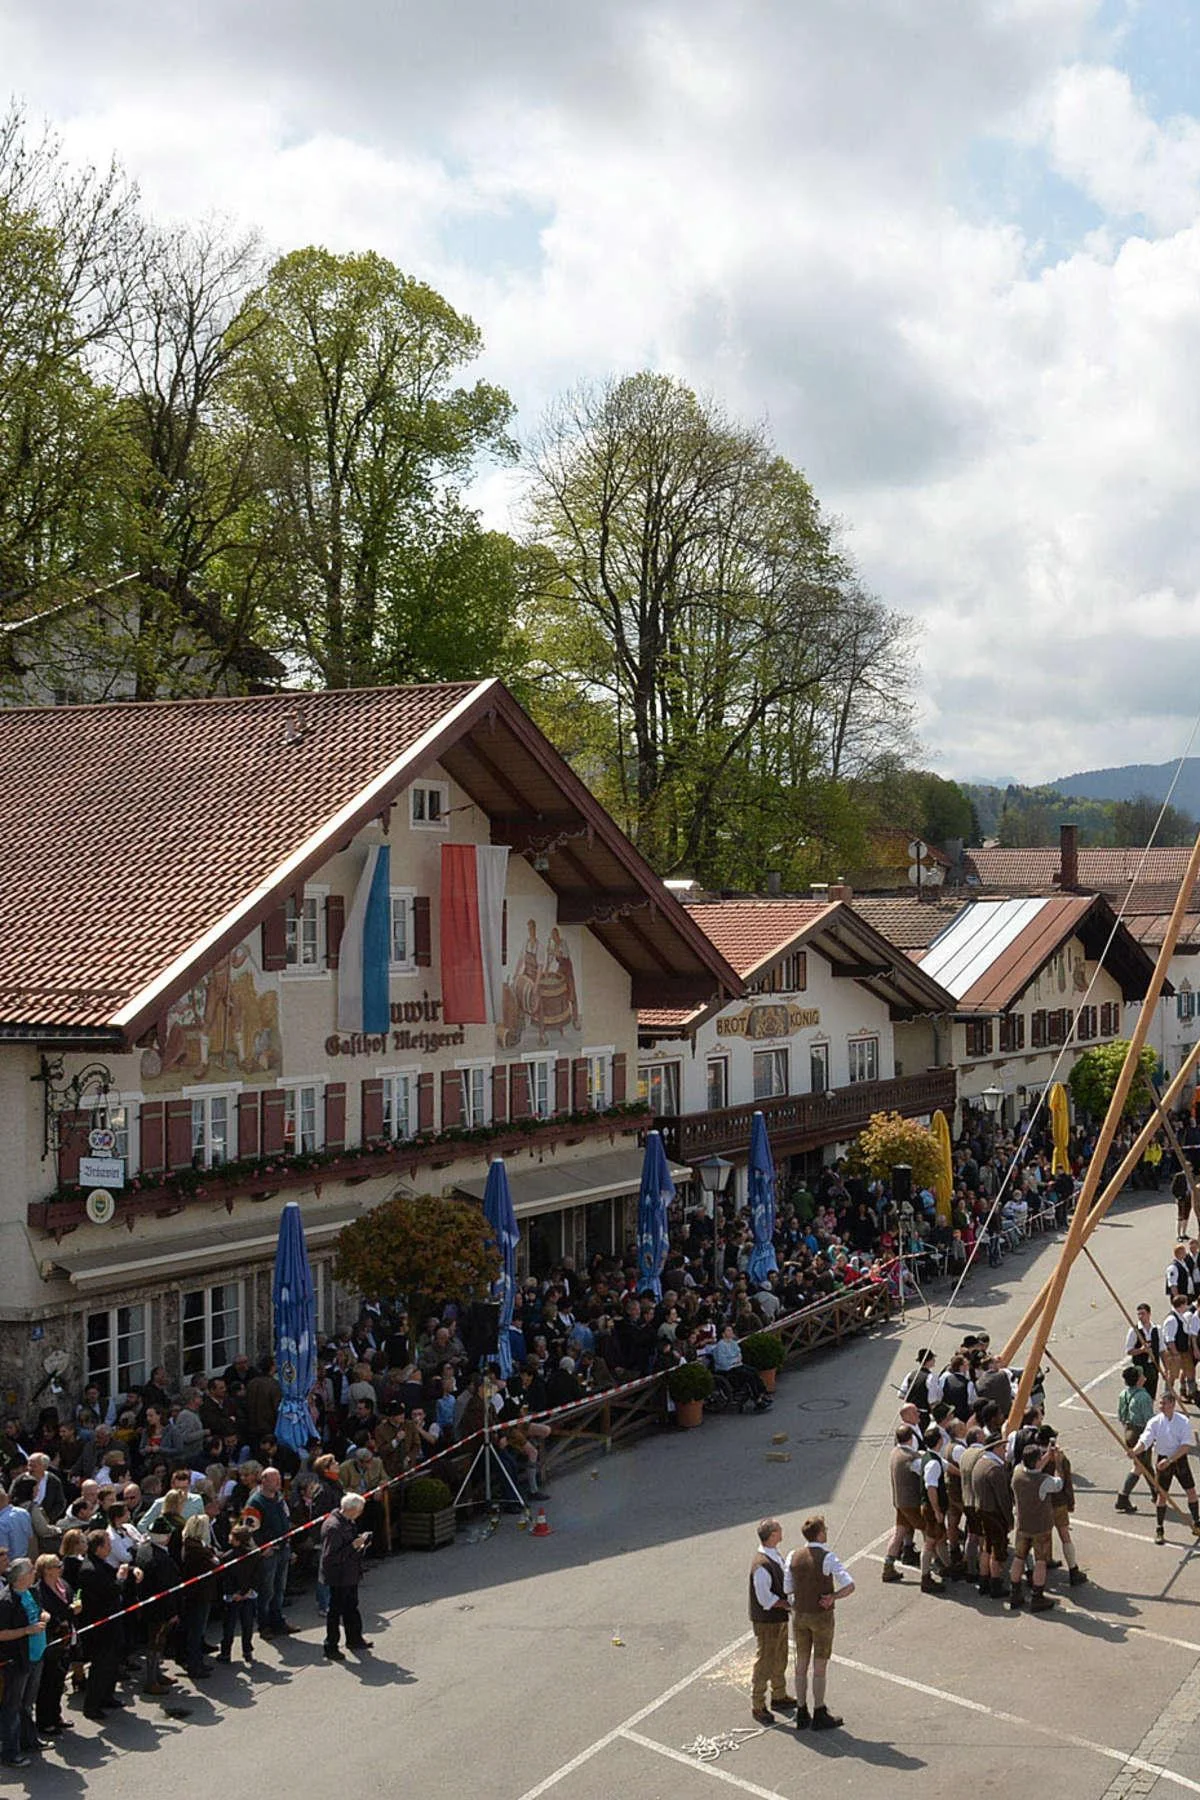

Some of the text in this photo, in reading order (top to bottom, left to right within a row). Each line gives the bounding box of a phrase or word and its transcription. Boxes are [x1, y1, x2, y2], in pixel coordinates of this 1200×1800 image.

[716, 1016, 747, 1036] BROT
[325, 1024, 466, 1057] Gasthof Metzgerei
